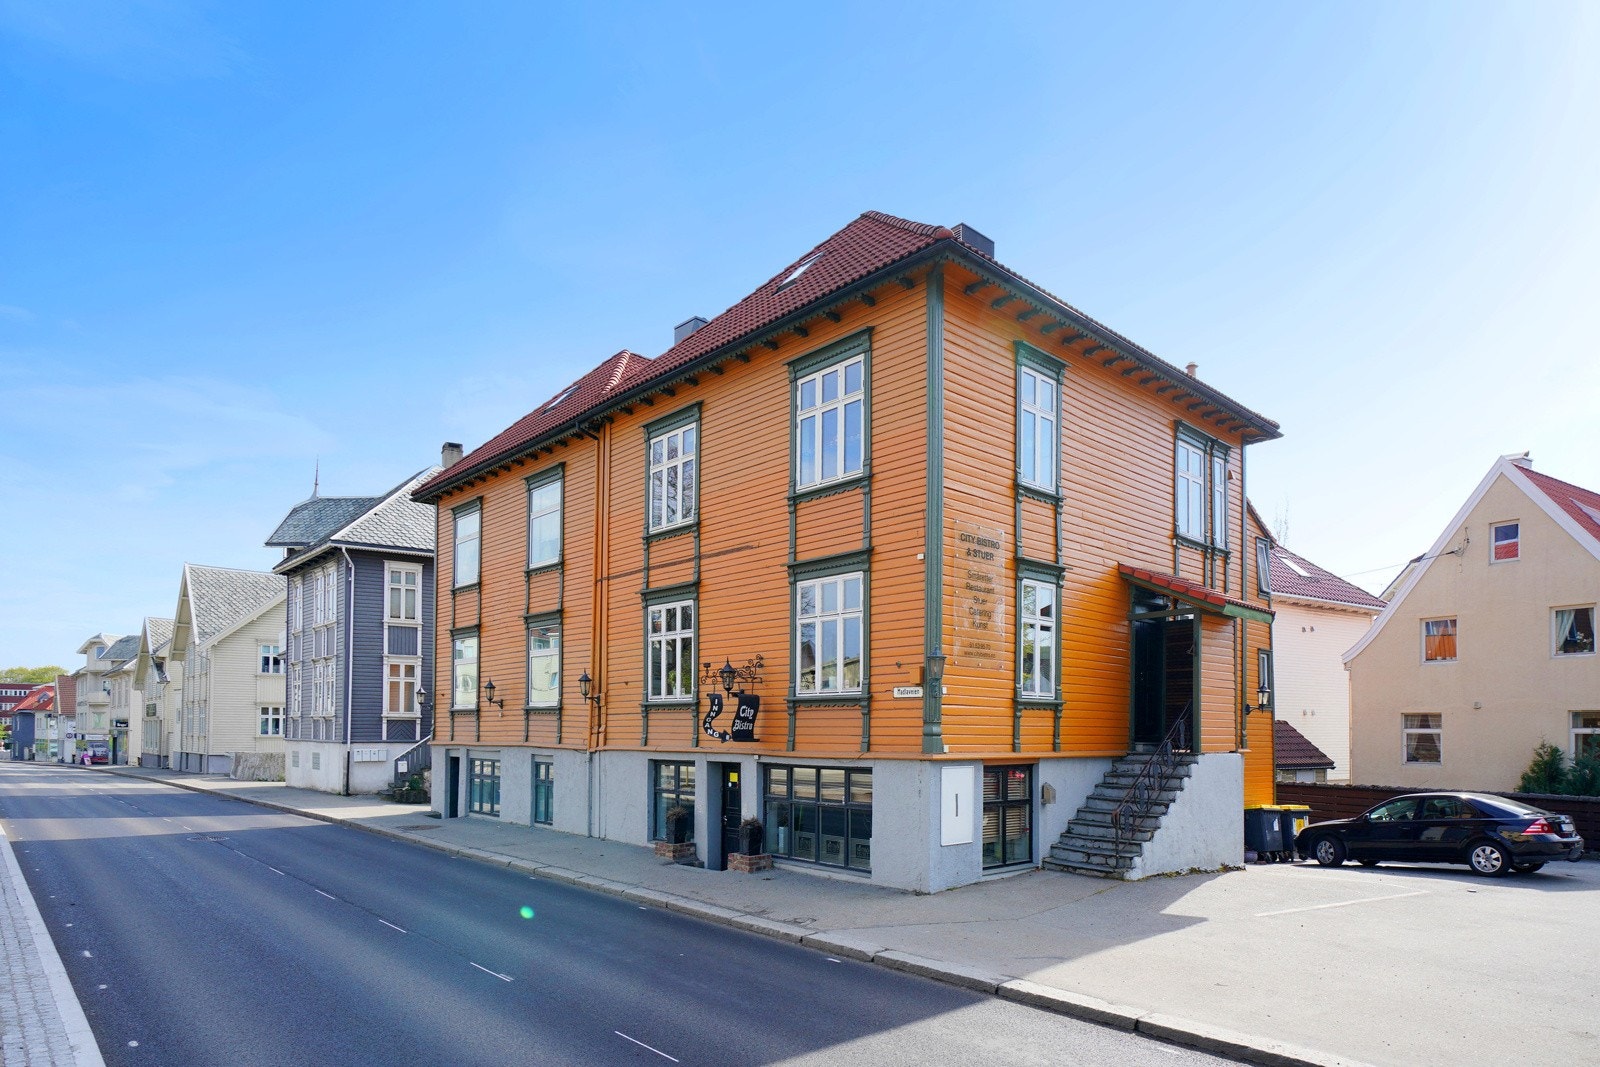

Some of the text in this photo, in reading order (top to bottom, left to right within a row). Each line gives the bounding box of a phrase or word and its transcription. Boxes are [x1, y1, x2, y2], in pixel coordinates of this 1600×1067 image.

[960, 532, 1000, 550] CITY BISTRO
[966, 547, 994, 561] & STUER
[965, 582, 995, 594] Restaurant
[968, 607, 992, 620] Catering
[972, 620, 988, 629] Kunst
[704, 698, 719, 738] INNGANG
[739, 705, 754, 719] City
[732, 719, 753, 731] Bistro
